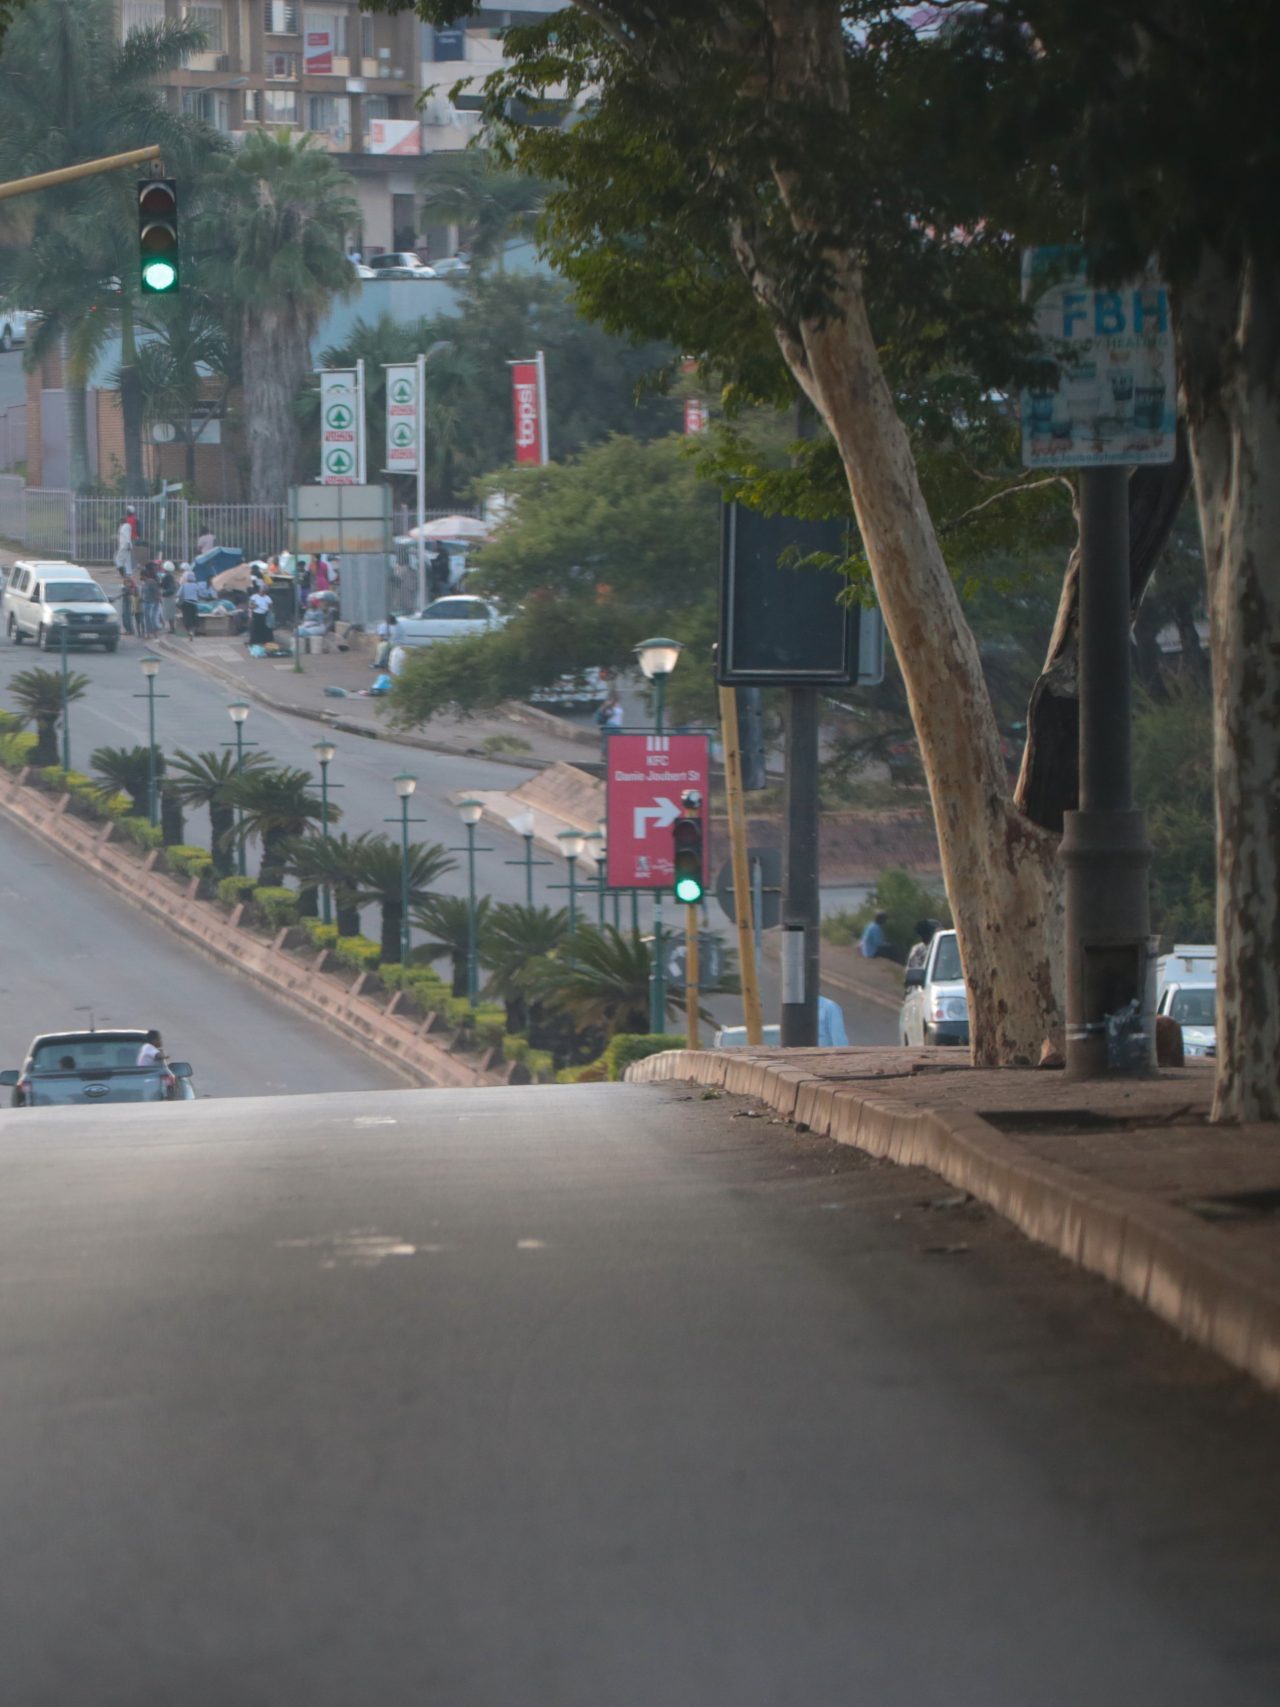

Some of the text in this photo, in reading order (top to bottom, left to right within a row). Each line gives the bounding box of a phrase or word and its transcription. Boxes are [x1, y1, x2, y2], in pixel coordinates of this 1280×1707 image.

[1063, 290, 1167, 335] FBH
[646, 755, 669, 766] KFC
[646, 770, 687, 781] Joubert
